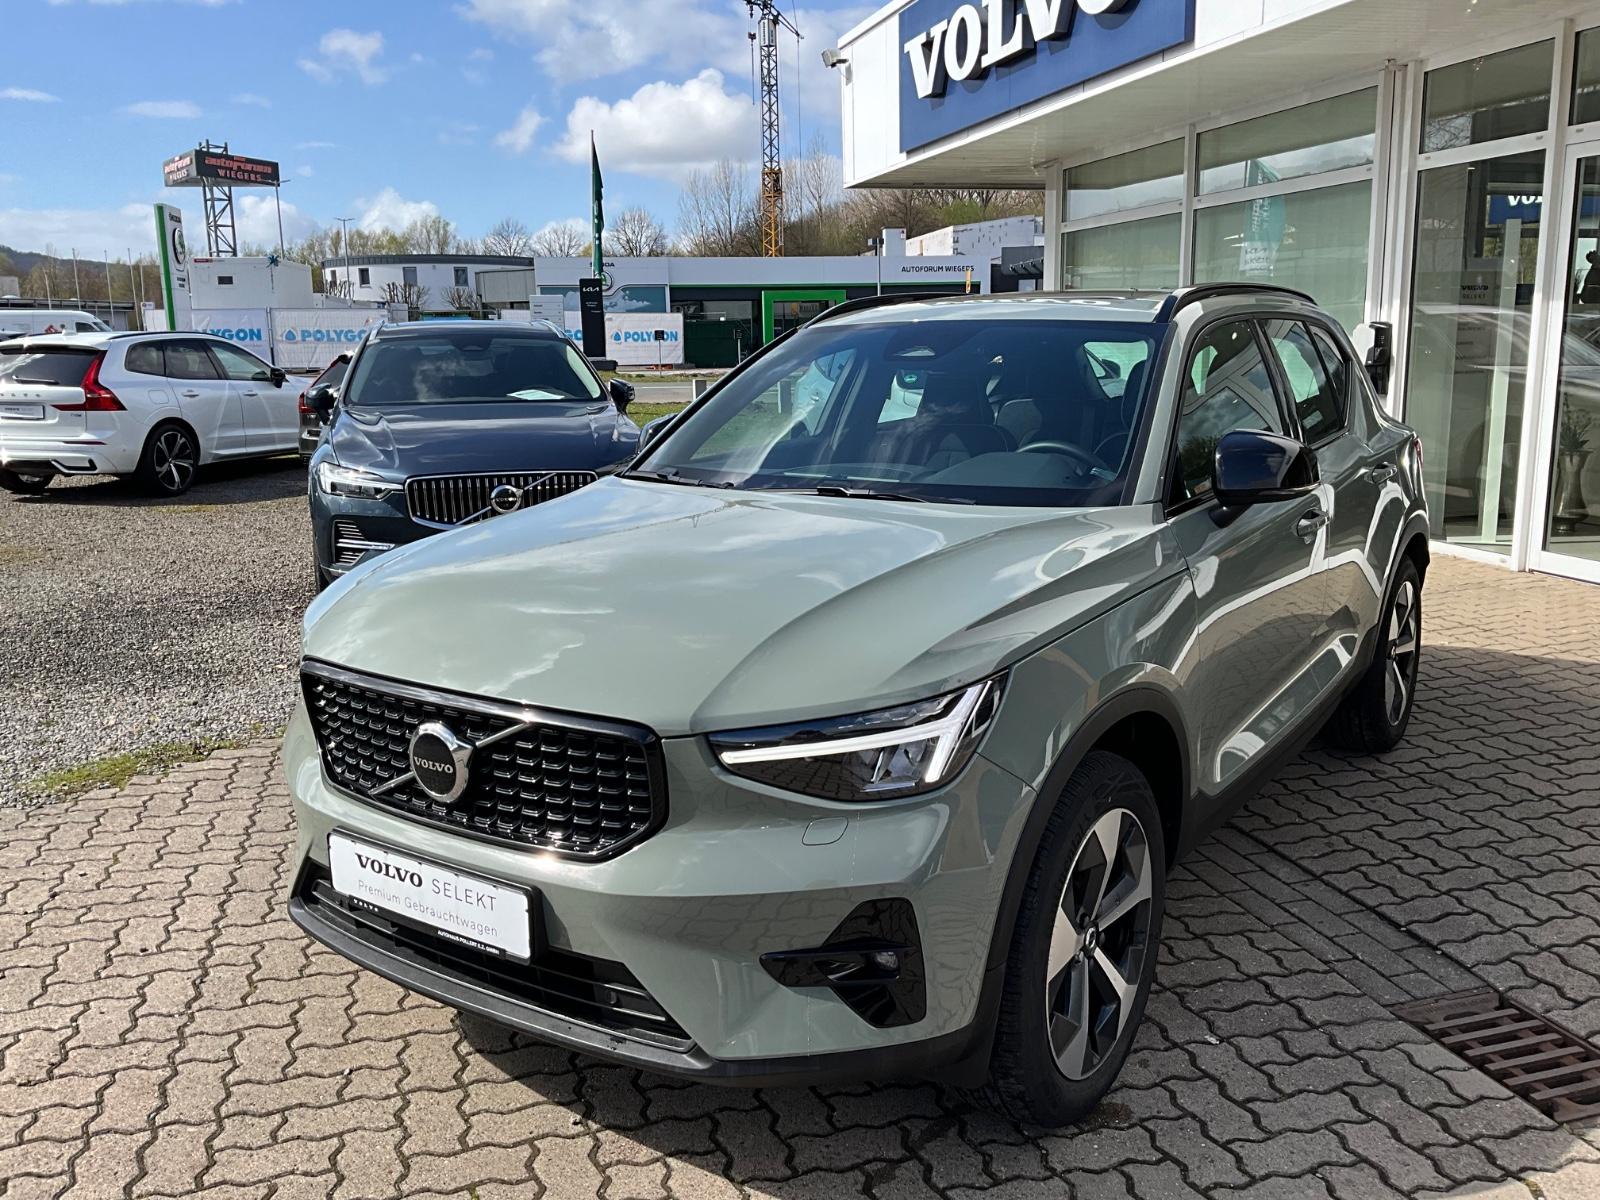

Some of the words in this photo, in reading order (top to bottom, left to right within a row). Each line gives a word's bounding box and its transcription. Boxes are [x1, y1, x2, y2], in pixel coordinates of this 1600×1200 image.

[904, 0, 1114, 99] VOLV
[901, 265, 944, 273] AUTOFORUM
[624, 331, 678, 342] POLYON
[413, 756, 454, 775] VOLVO
[355, 852, 423, 888] VOLVO
[431, 878, 497, 912] SELEKT
[358, 879, 401, 904] Premium
[404, 896, 498, 937] Gebrauchtwagen
